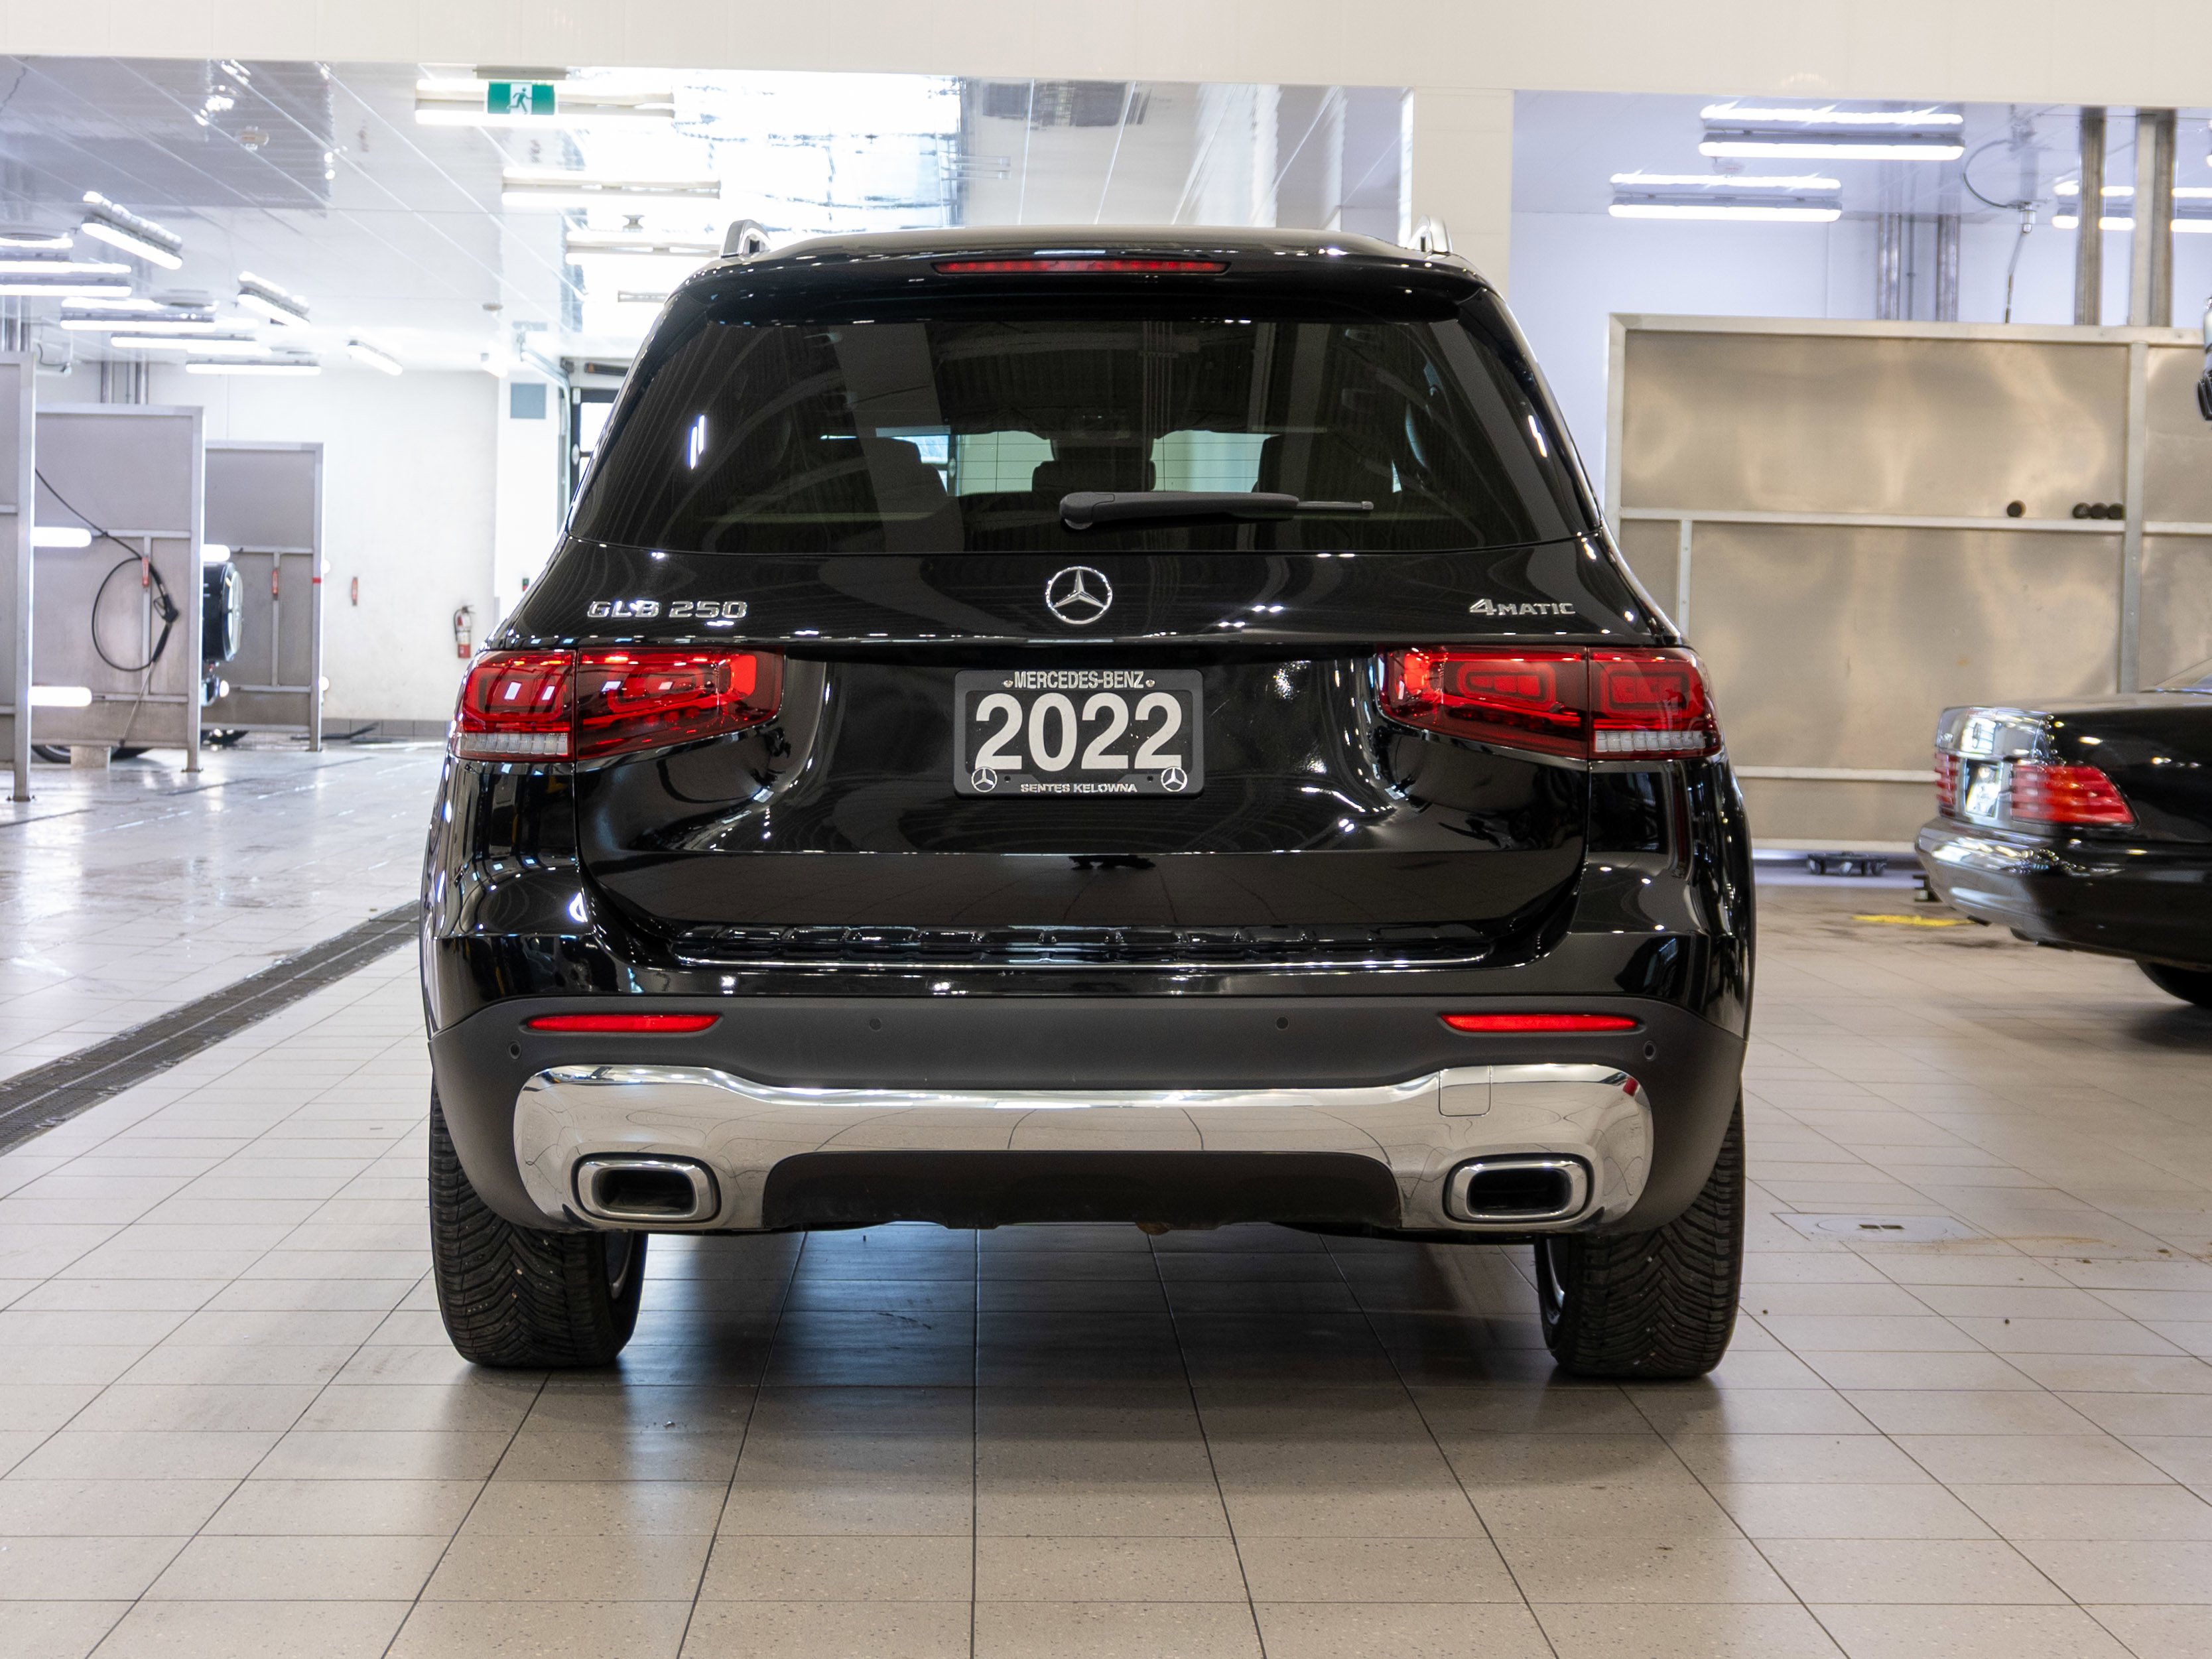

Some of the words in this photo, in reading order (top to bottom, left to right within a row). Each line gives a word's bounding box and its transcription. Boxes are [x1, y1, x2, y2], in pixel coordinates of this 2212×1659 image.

[587, 600, 661, 618] GLB
[668, 600, 748, 618] 250
[1014, 671, 1145, 689] MERCEDES-BENZ
[974, 692, 1183, 772] 2022
[1020, 783, 1071, 793] SENTES
[1073, 783, 1138, 793] KELOWNA
